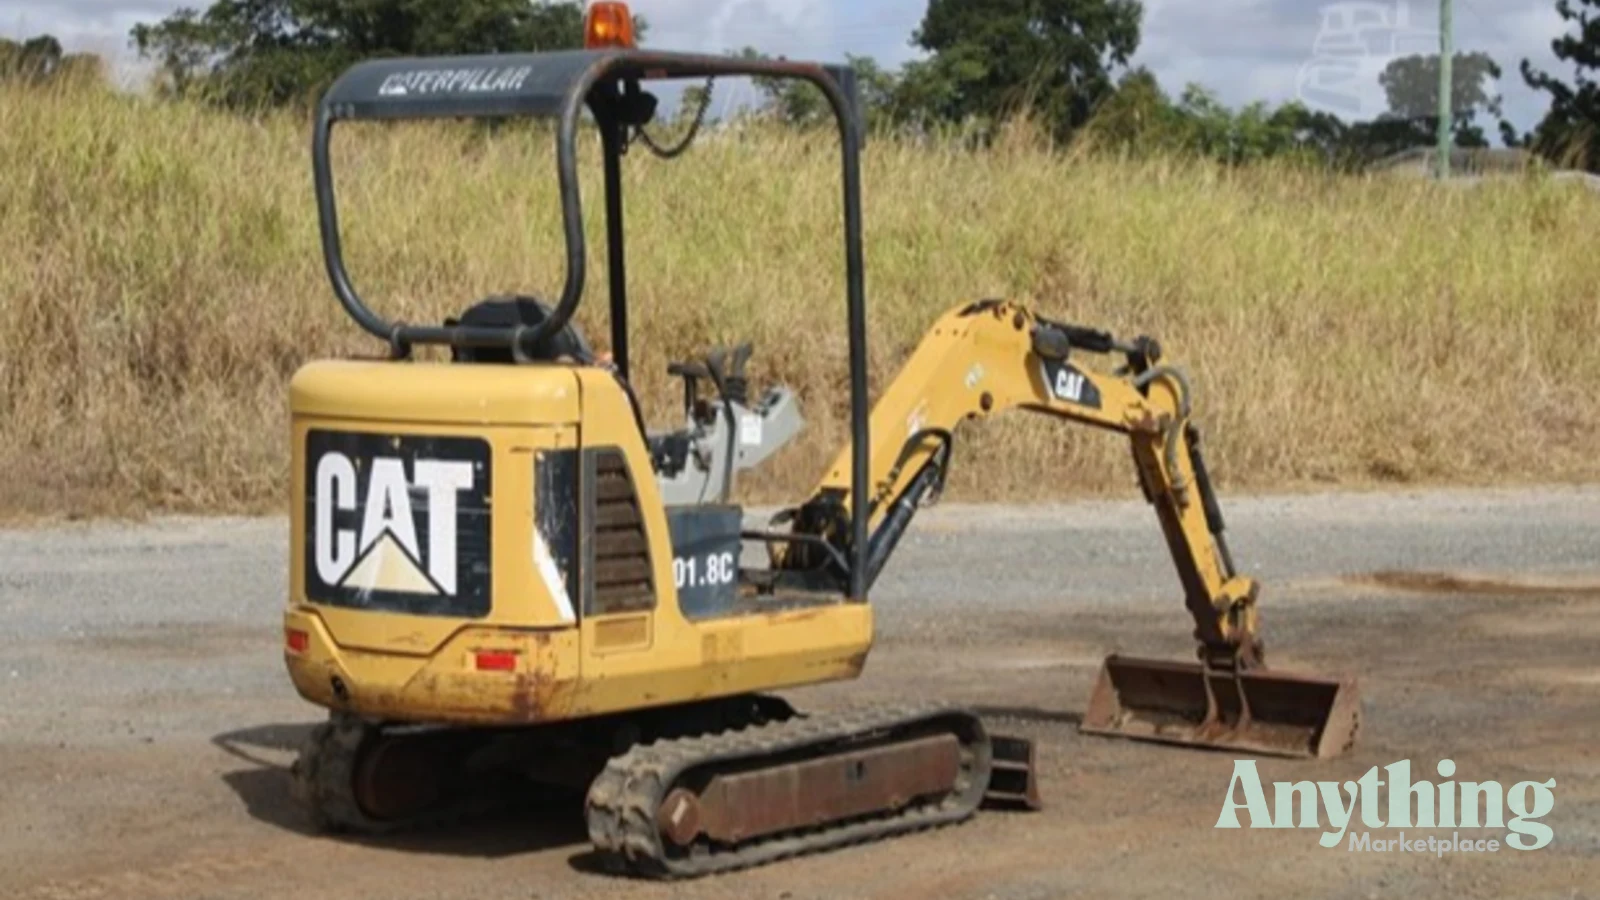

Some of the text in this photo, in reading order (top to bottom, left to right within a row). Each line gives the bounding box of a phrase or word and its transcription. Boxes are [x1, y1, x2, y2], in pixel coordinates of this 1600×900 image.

[378, 65, 532, 96] CATERPILLAR
[1055, 368, 1085, 401] CAT
[315, 452, 473, 596] CAT
